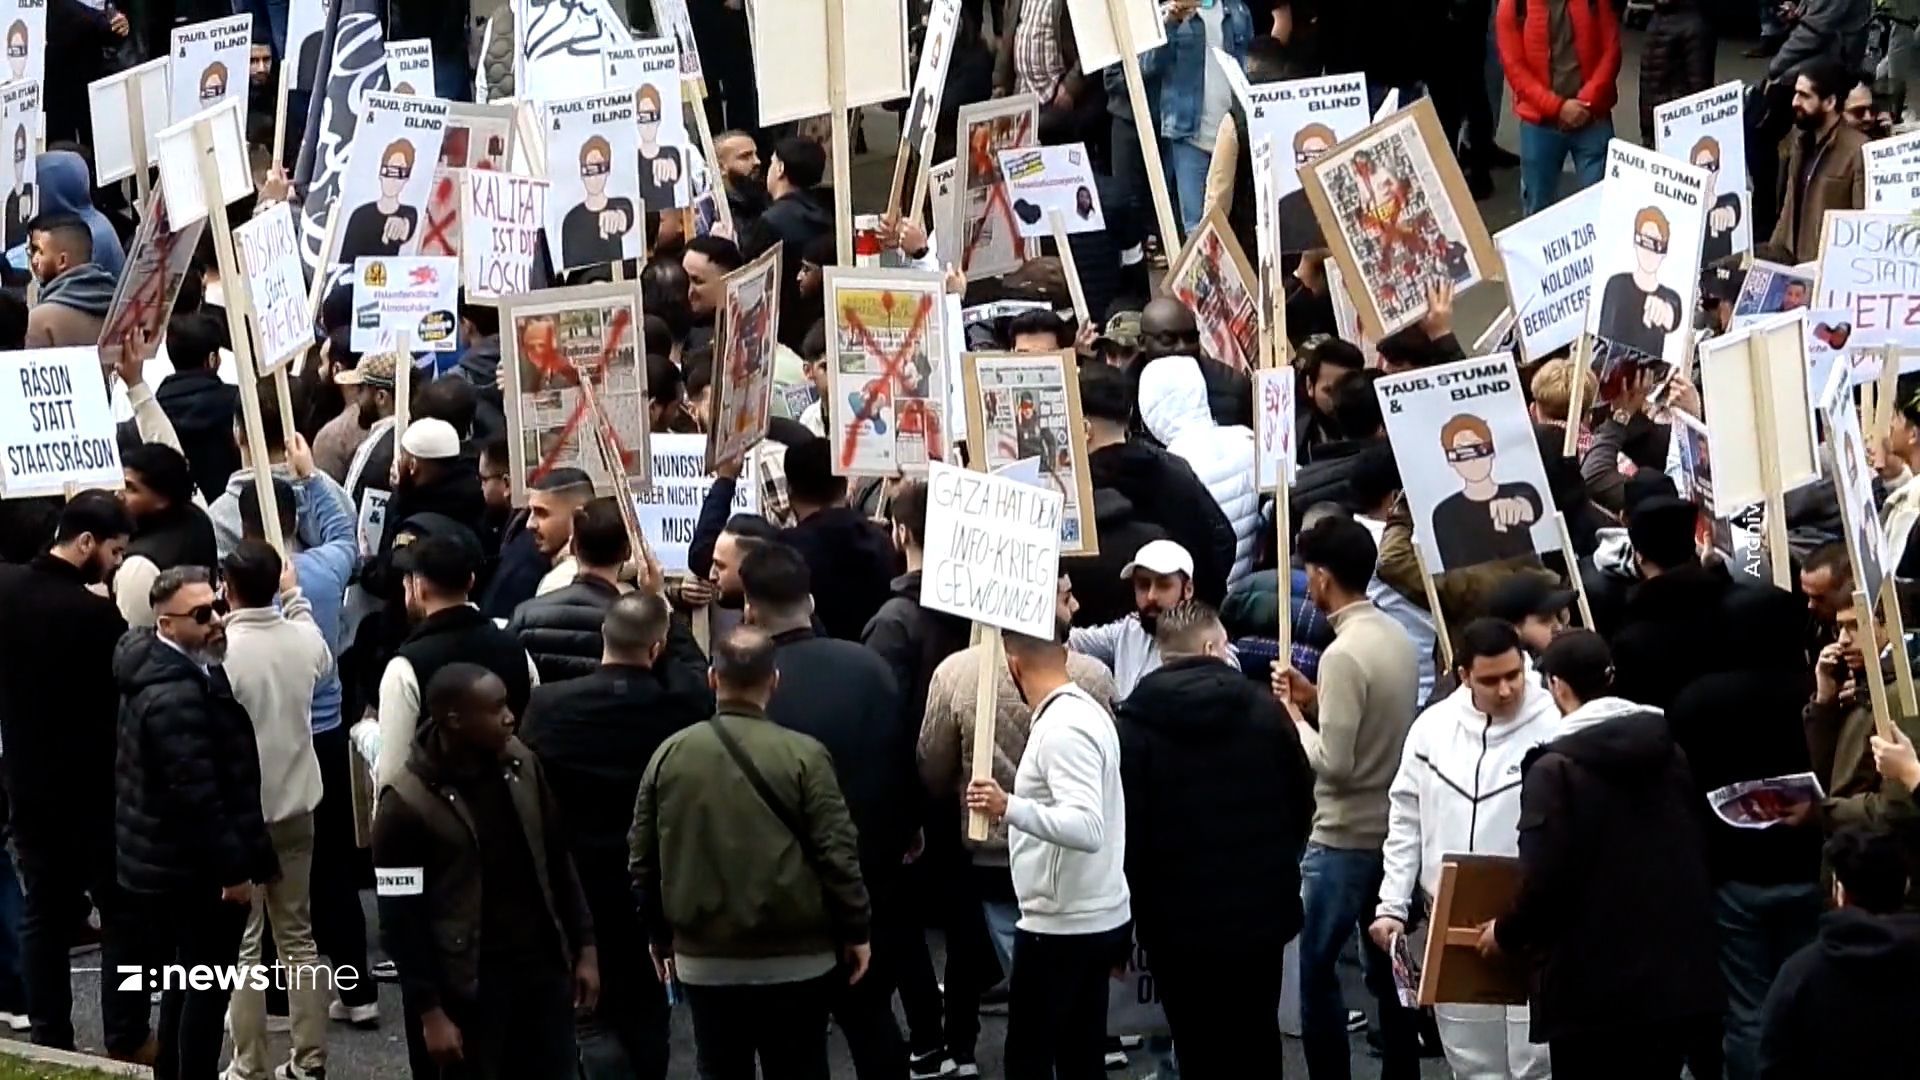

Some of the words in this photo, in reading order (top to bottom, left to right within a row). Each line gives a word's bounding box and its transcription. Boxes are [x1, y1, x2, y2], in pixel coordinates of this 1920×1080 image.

[210, 22, 249, 38] STUMM
[214, 36, 248, 51] BLIND
[397, 46, 429, 58] STUMM
[637, 45, 675, 57] STUMM
[400, 58, 430, 71] BLIND
[610, 64, 617, 76] &
[643, 60, 675, 72] BLIND
[1299, 82, 1360, 98] STUMM
[1696, 90, 1738, 113] STUMM
[402, 102, 447, 116] STUMM
[586, 94, 633, 110] STUMM
[1254, 106, 1264, 118] &
[1308, 97, 1360, 112] BLIND
[366, 111, 375, 124] &
[404, 117, 442, 130] BLIND
[552, 118, 561, 131] &
[592, 109, 633, 124] BLIND
[1663, 125, 1671, 137] &
[1701, 104, 1738, 126] BLIND
[935, 169, 954, 183] TA
[1611, 148, 1648, 172] TAUB,
[1651, 163, 1701, 190] STUMM
[1611, 165, 1620, 179] &
[1654, 180, 1698, 206] BLIND
[472, 174, 550, 226] KALIFAT
[492, 227, 515, 254] IST
[1543, 237, 1572, 265] NEIN
[1572, 223, 1597, 254] ZUR
[479, 253, 531, 295] LÖSU
[20, 361, 72, 398] RÄSON
[1380, 378, 1435, 398] TAUB,
[1437, 362, 1508, 386] STUMM
[1389, 400, 1403, 414] &
[1450, 380, 1511, 402] BLIND
[30, 400, 76, 432] STATT
[8, 435, 115, 476] STAATSRÄSON
[667, 486, 698, 506] NICHT
[934, 471, 990, 518] GAZA
[995, 483, 1026, 523] HAT
[1030, 494, 1062, 532] DEN
[369, 510, 381, 524] &
[950, 520, 1050, 586] INFO-KRIEG
[936, 560, 1049, 624] GEWONNEN
